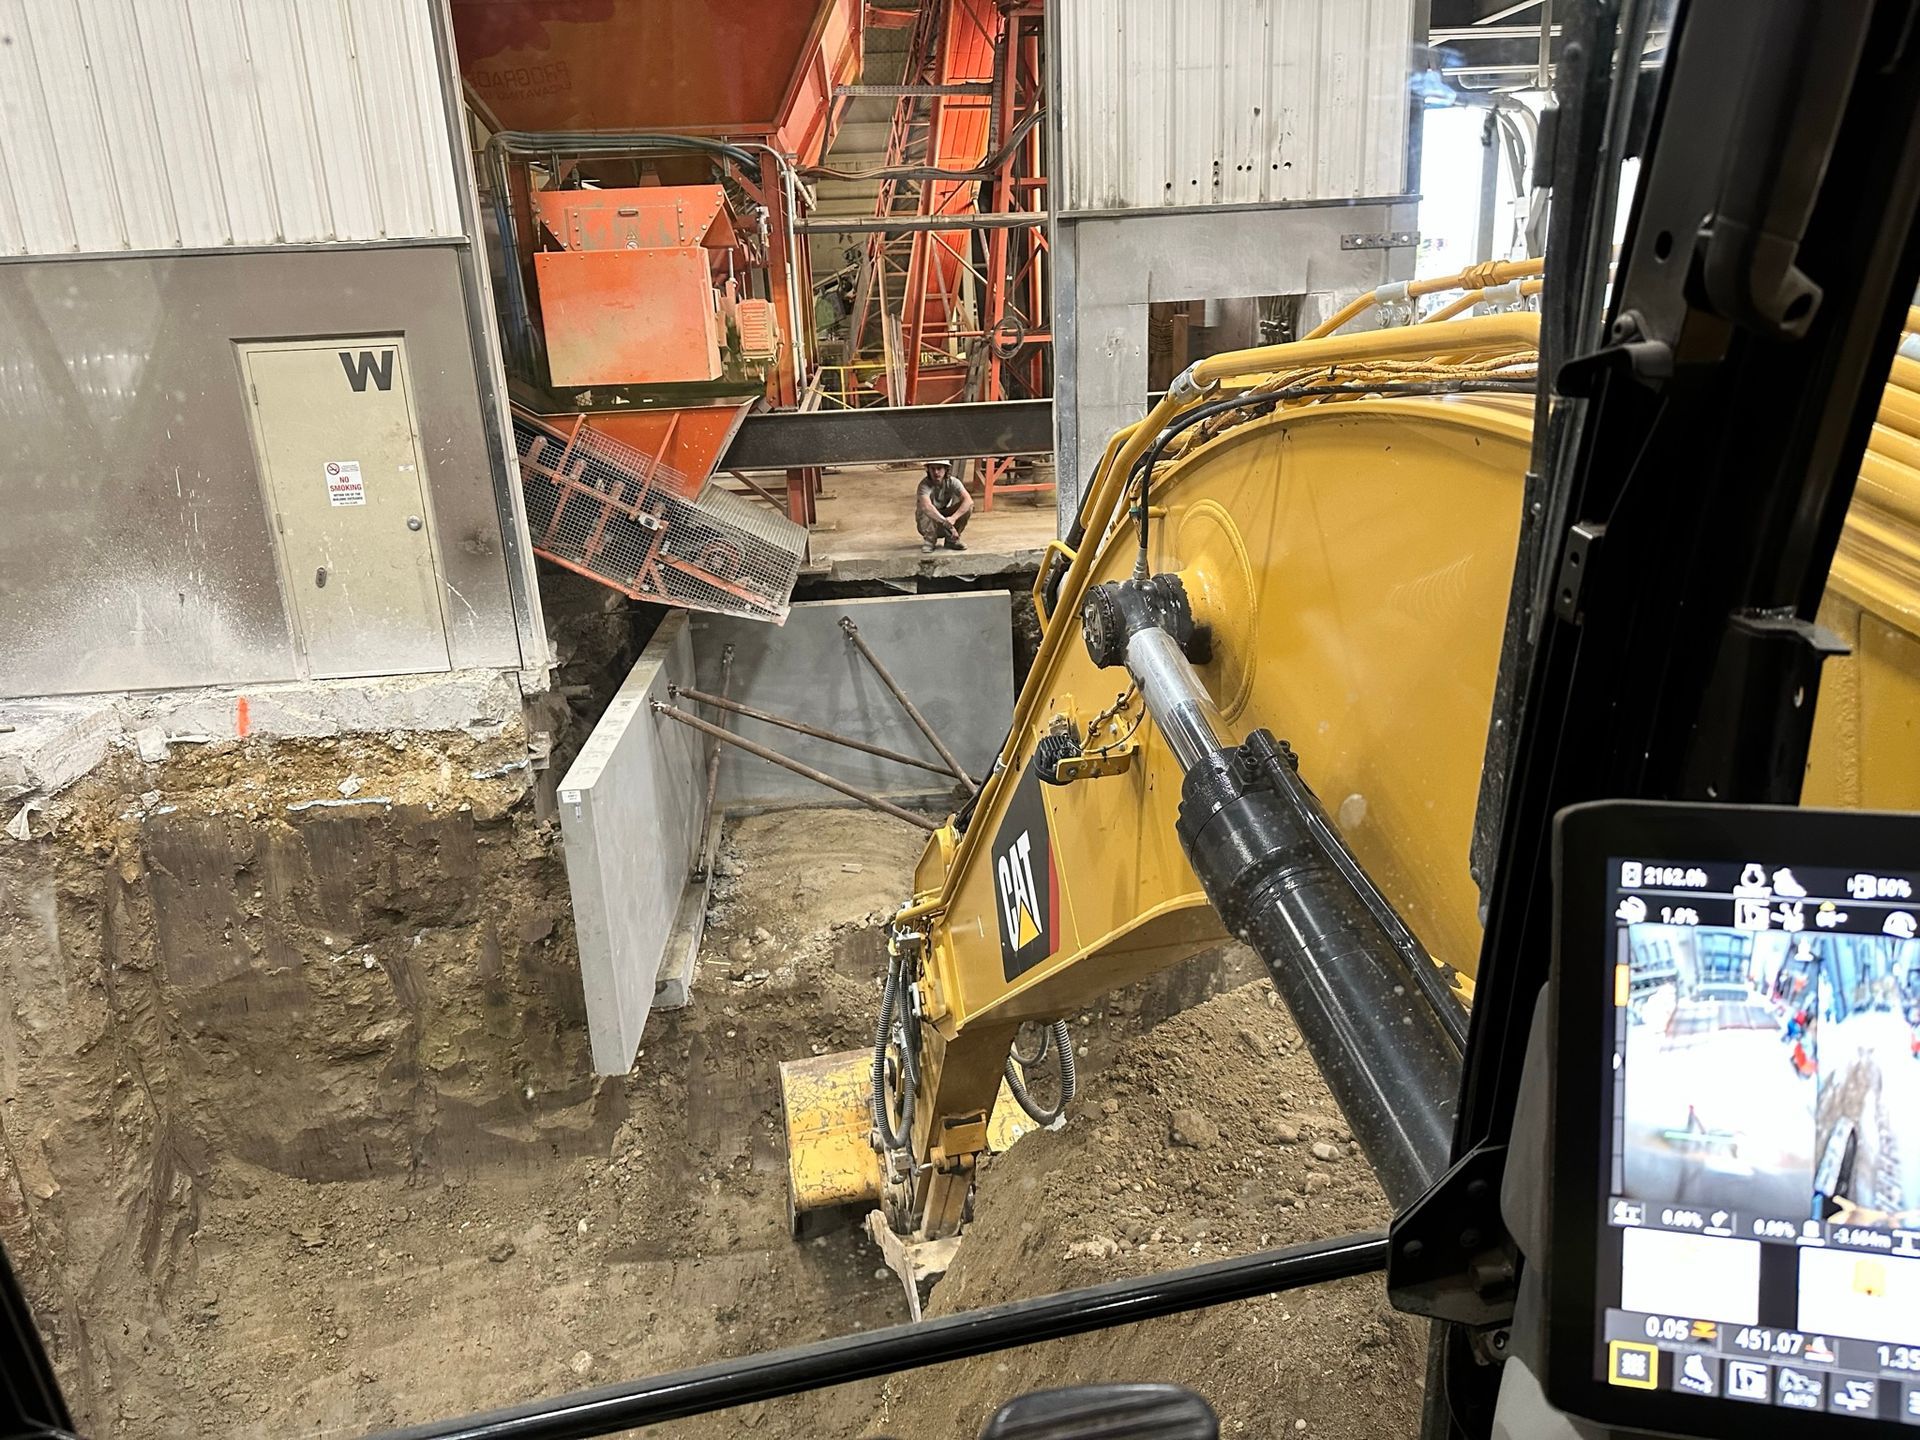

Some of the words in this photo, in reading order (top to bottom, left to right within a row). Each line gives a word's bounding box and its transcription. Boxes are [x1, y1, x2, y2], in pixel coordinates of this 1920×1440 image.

[338, 351, 394, 392] W
[330, 484, 362, 492] SMOKING
[998, 829, 1043, 952] CAT
[1645, 1315, 1689, 1340] 0.05
[1735, 1327, 1804, 1354] 451.07
